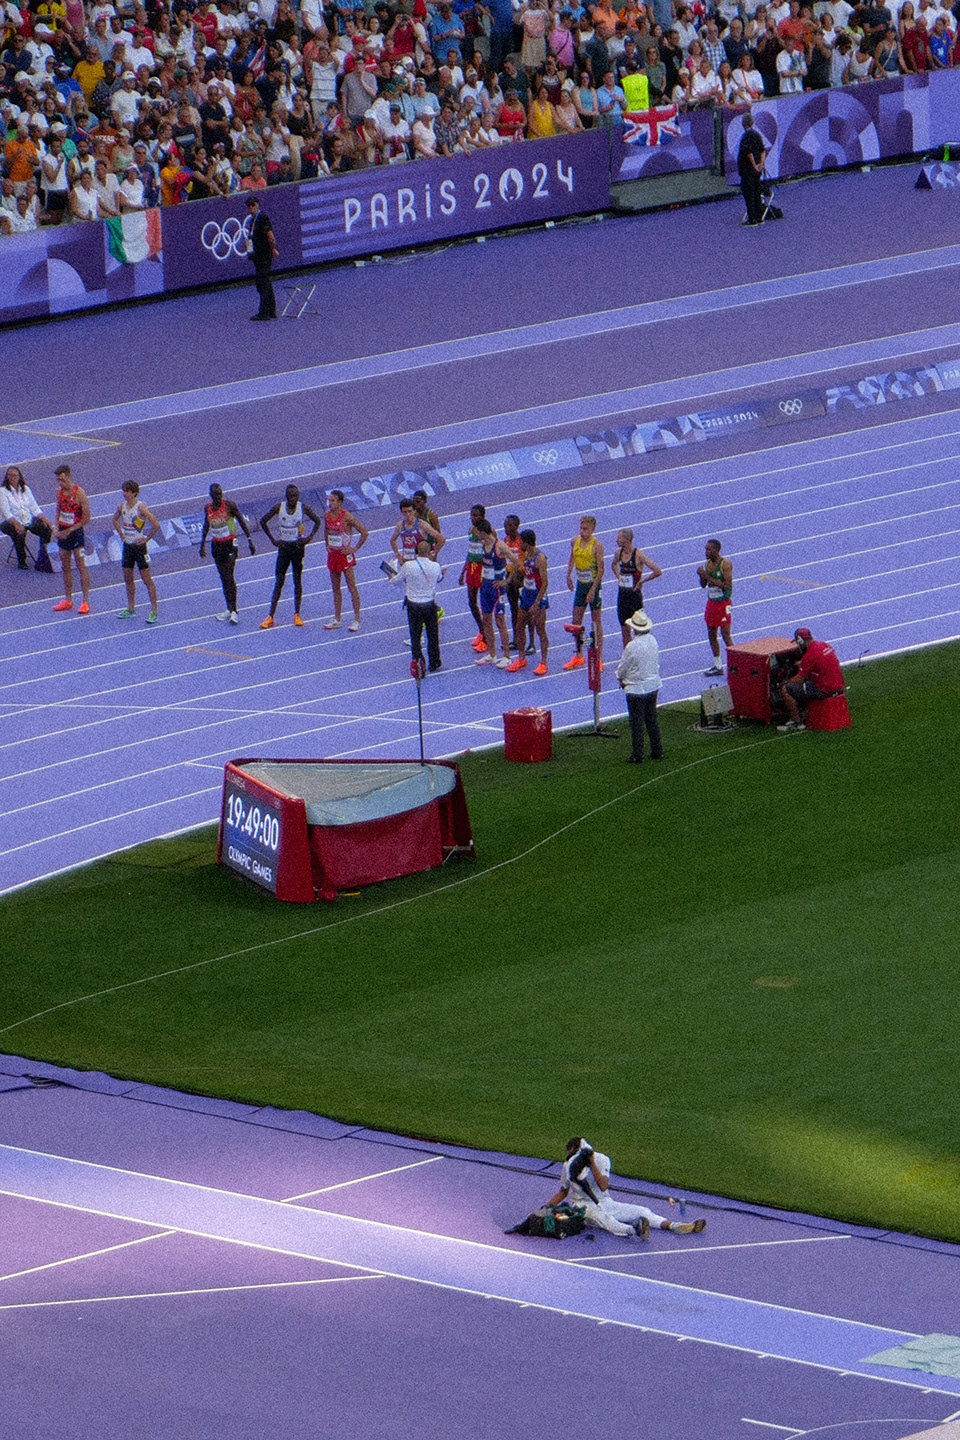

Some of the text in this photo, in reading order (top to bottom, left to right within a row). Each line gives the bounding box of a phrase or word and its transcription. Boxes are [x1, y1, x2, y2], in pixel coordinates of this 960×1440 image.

[474, 159, 574, 208] 2024
[734, 411, 758, 422] 2024
[226, 794, 279, 850] 19:49:00
[228, 846, 272, 882] OLYMPIC GAMES
